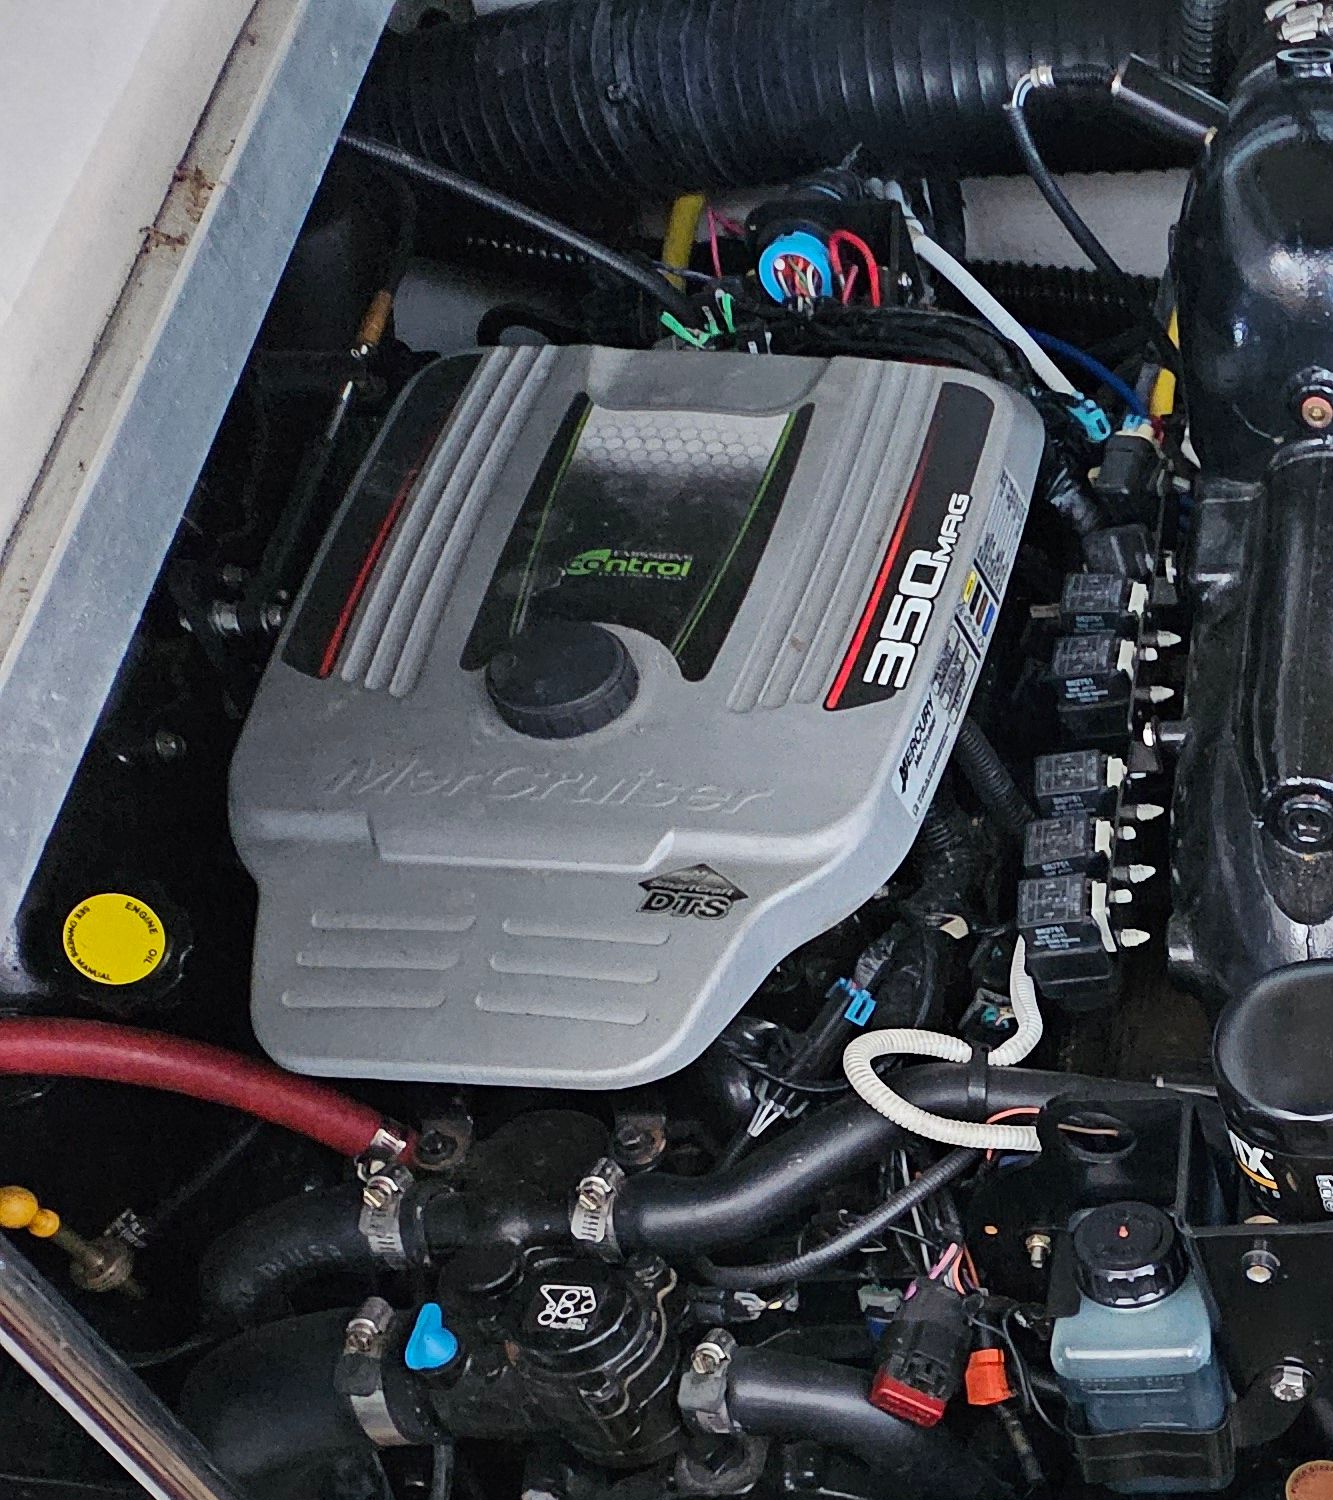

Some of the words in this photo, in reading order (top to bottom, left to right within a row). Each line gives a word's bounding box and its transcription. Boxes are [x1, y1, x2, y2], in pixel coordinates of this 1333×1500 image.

[863, 549, 948, 689] 350
[929, 493, 971, 563] MAG
[897, 692, 936, 794] MERCURY
[329, 758, 776, 815] MerCruiser
[74, 905, 91, 920] SEE
[124, 901, 159, 935] ENGINE
[143, 948, 158, 965] OIL
[637, 888, 733, 921] DTS
[76, 958, 112, 981] MANUAL
